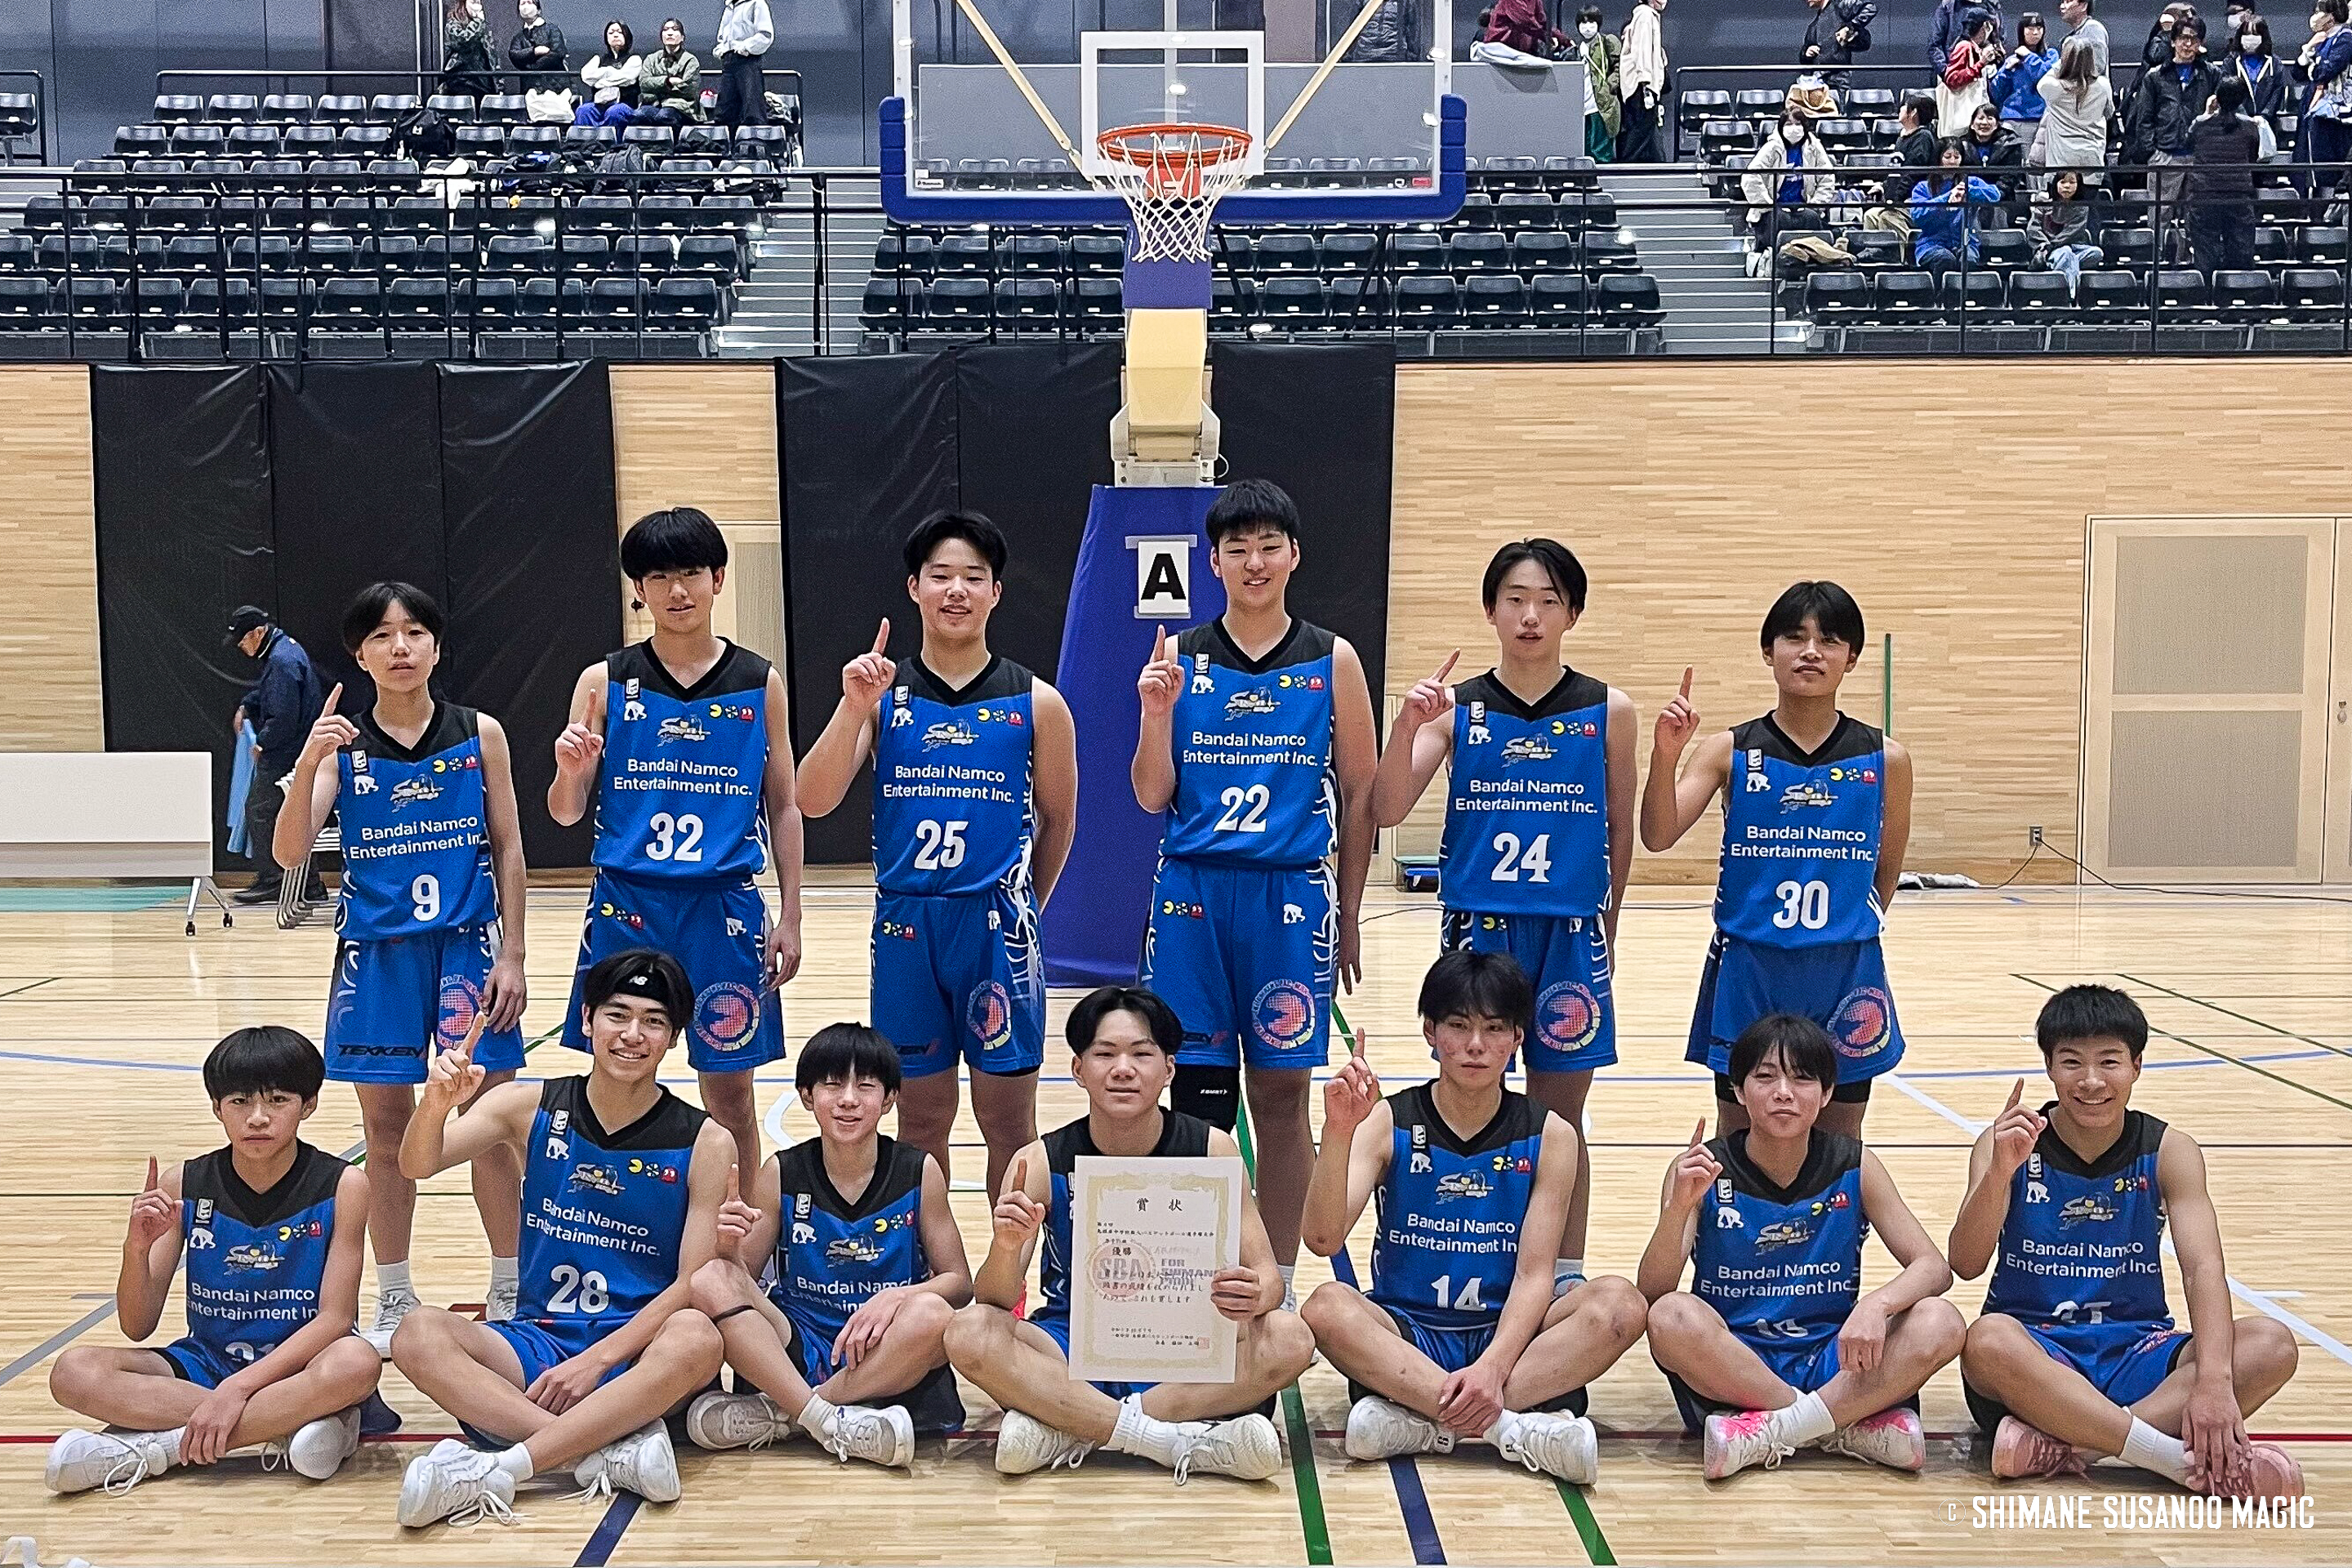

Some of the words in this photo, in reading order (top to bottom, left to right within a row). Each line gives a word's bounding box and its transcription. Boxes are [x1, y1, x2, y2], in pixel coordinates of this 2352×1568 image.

[1140, 553, 1187, 600] A
[1192, 731, 1249, 746] Bandai
[1251, 733, 1306, 746] Namco
[627, 757, 679, 773] Bandai
[680, 760, 738, 777] Namco
[1183, 750, 1291, 765] Entertainment
[1292, 751, 1318, 767] Inc.
[895, 764, 945, 778] Bandai
[947, 765, 1005, 782] Namco
[613, 777, 722, 794] Entertainment
[724, 782, 753, 795] Inc.
[883, 782, 989, 800] Entertainment
[991, 787, 1015, 804] Inc.
[1470, 778, 1524, 793] Bandai
[1526, 780, 1584, 795] Namco
[1213, 783, 1270, 833] 22
[1455, 797, 1570, 813] Entertainment
[1571, 800, 1598, 813] Inc.
[361, 821, 418, 840] Bandai
[421, 817, 478, 834] Namco
[645, 812, 704, 862] 32
[1746, 825, 1804, 840] Bandai
[1807, 826, 1866, 842] Namco
[350, 835, 465, 859] Entertainment
[466, 832, 482, 846] In
[914, 819, 969, 871] 25
[1731, 843, 1849, 860] Entertainment
[1490, 832, 1552, 883] 24
[412, 874, 440, 921] 9
[1772, 880, 1829, 929] 30
[542, 1197, 586, 1225] Bandai
[586, 1210, 649, 1239] Namco
[1407, 1213, 1460, 1232] Bandai
[1463, 1218, 1516, 1234] Namco
[526, 1210, 628, 1250] Entertainment
[631, 1240, 660, 1256] Inc.
[1389, 1228, 1499, 1254] Entertainment
[1502, 1238, 1517, 1253] In
[2022, 1239, 2084, 1257] Bandai
[2088, 1242, 2144, 1258] Namco
[1718, 1264, 1780, 1280] Bandai
[1784, 1262, 1841, 1278] Namco
[2006, 1251, 2127, 1279] Entertainment
[2130, 1258, 2160, 1274] Inc.
[191, 1282, 249, 1303] Bandai
[254, 1289, 315, 1303] Namco
[546, 1264, 609, 1314] 28
[797, 1276, 854, 1294] Bandai
[1700, 1279, 1824, 1298] Entertainment
[302, 1307, 318, 1320] In
